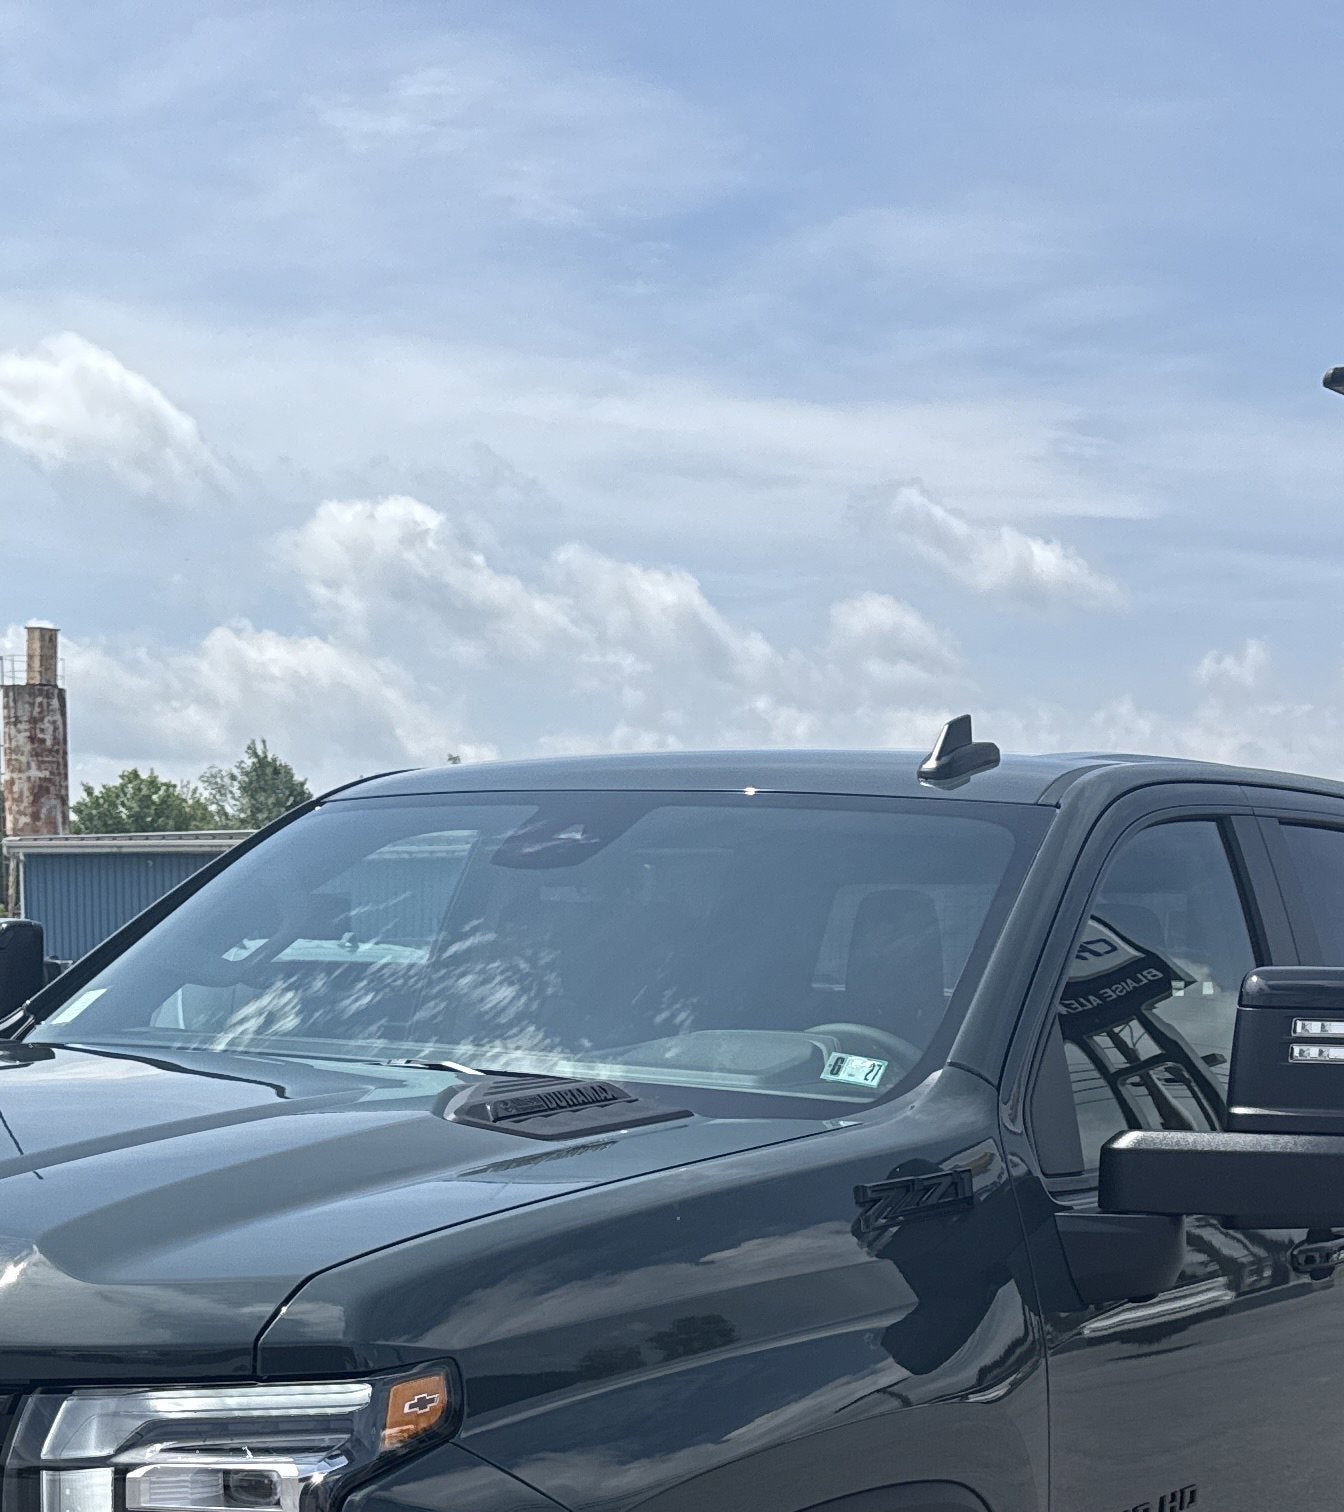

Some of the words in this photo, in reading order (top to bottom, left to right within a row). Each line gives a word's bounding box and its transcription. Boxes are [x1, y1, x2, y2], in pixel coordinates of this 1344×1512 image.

[829, 1056, 846, 1076] 6
[863, 1062, 883, 1083] 27
[537, 1084, 618, 1111] DURAMAX
